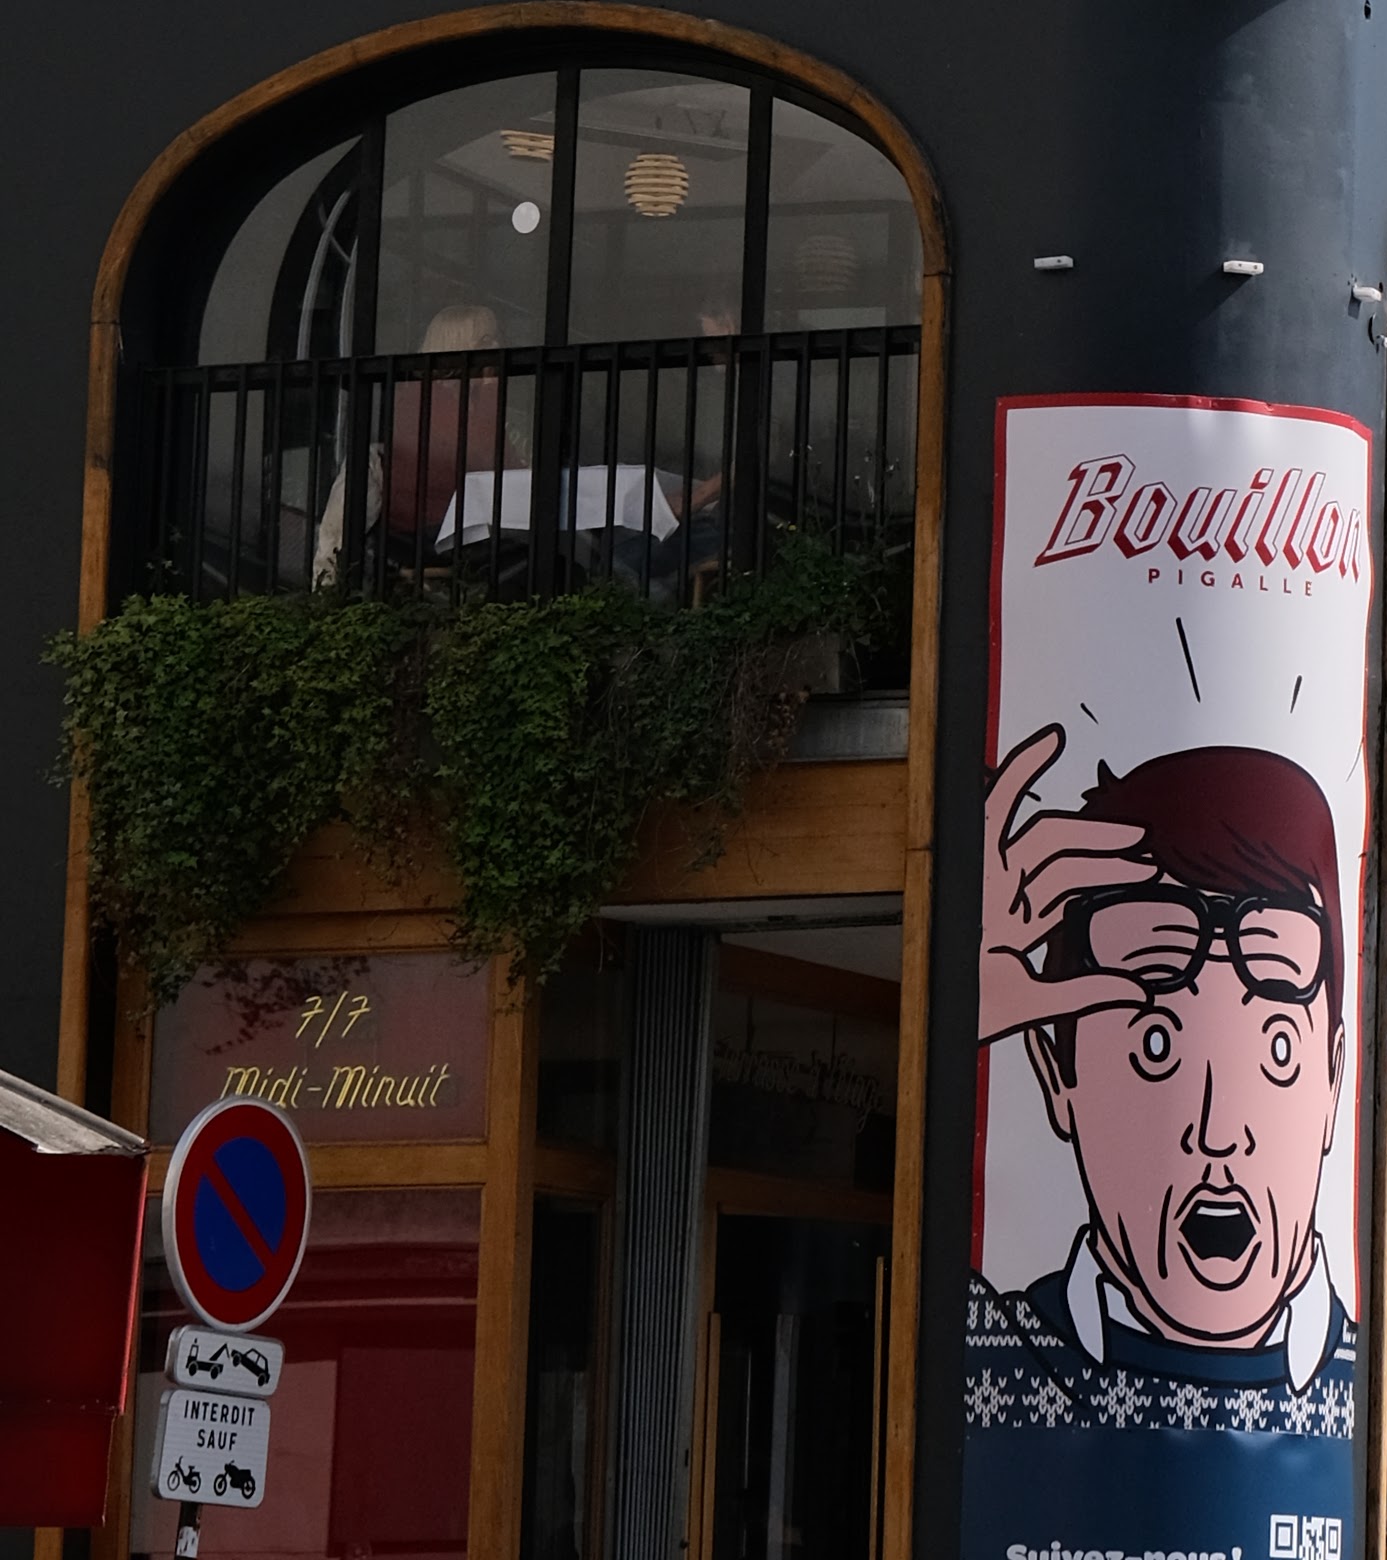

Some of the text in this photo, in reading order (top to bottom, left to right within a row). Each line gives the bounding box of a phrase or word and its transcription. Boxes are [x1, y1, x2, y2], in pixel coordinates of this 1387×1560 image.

[1033, 453, 1362, 583] Bouillon
[1148, 567, 1313, 597] PIGALLE
[295, 990, 371, 1048] 7/7
[220, 1062, 451, 1110] Midi-Minuit
[184, 1399, 256, 1427] INTERDIT
[196, 1428, 238, 1451] SAUF
